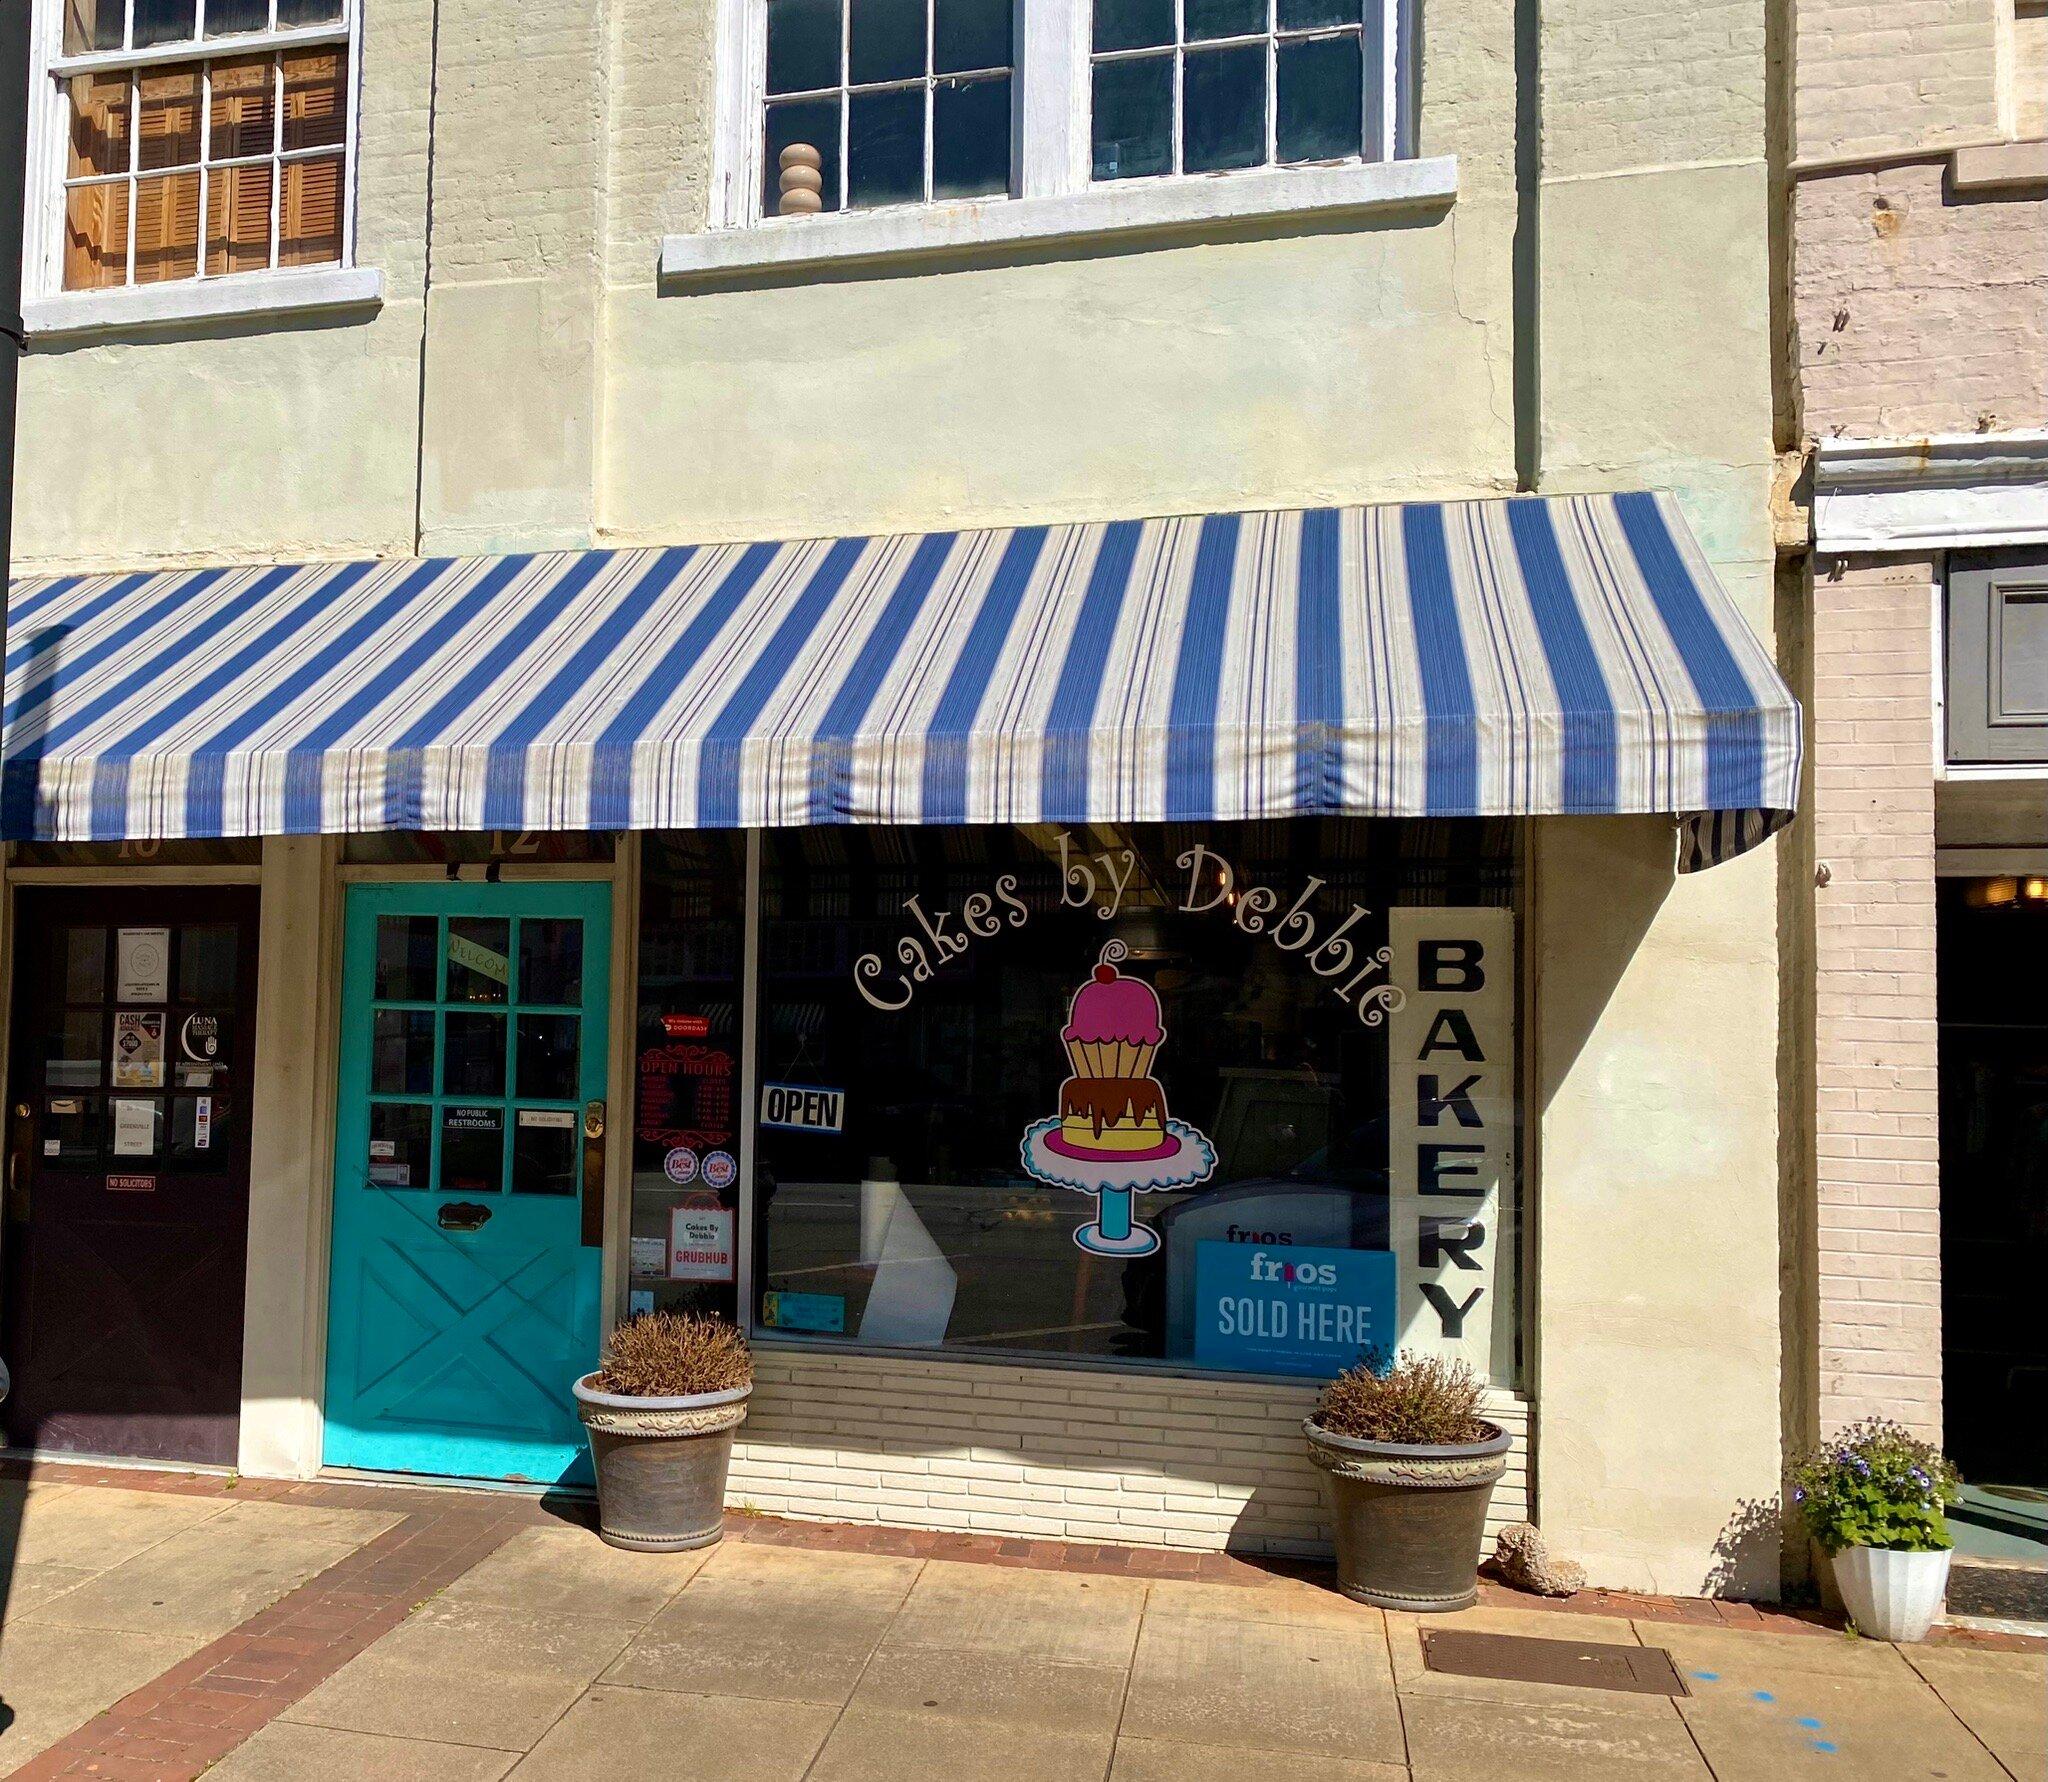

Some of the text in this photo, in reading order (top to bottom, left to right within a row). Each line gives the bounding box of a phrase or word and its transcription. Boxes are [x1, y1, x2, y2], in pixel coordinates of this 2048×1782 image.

[853, 832, 1407, 1027] Cakes by Debbie
[447, 938, 507, 977] WELCOM
[119, 1014, 141, 1026] CASH
[192, 1016, 217, 1024] LUNA
[641, 1061, 732, 1077] OPEN HOURS
[456, 1109, 488, 1118] NO PUBLIC
[767, 1087, 839, 1128] OPEN
[448, 1119, 496, 1128] RESTROOMS
[1417, 939, 1486, 1339] BAKERY
[109, 1178, 153, 1188] NO SOLICITORS
[685, 1223, 719, 1232] Cakes By
[689, 1232, 715, 1240] Debbie
[675, 1250, 728, 1264] GRUBHUB
[1218, 1296, 1372, 1345] SOLD HERE
